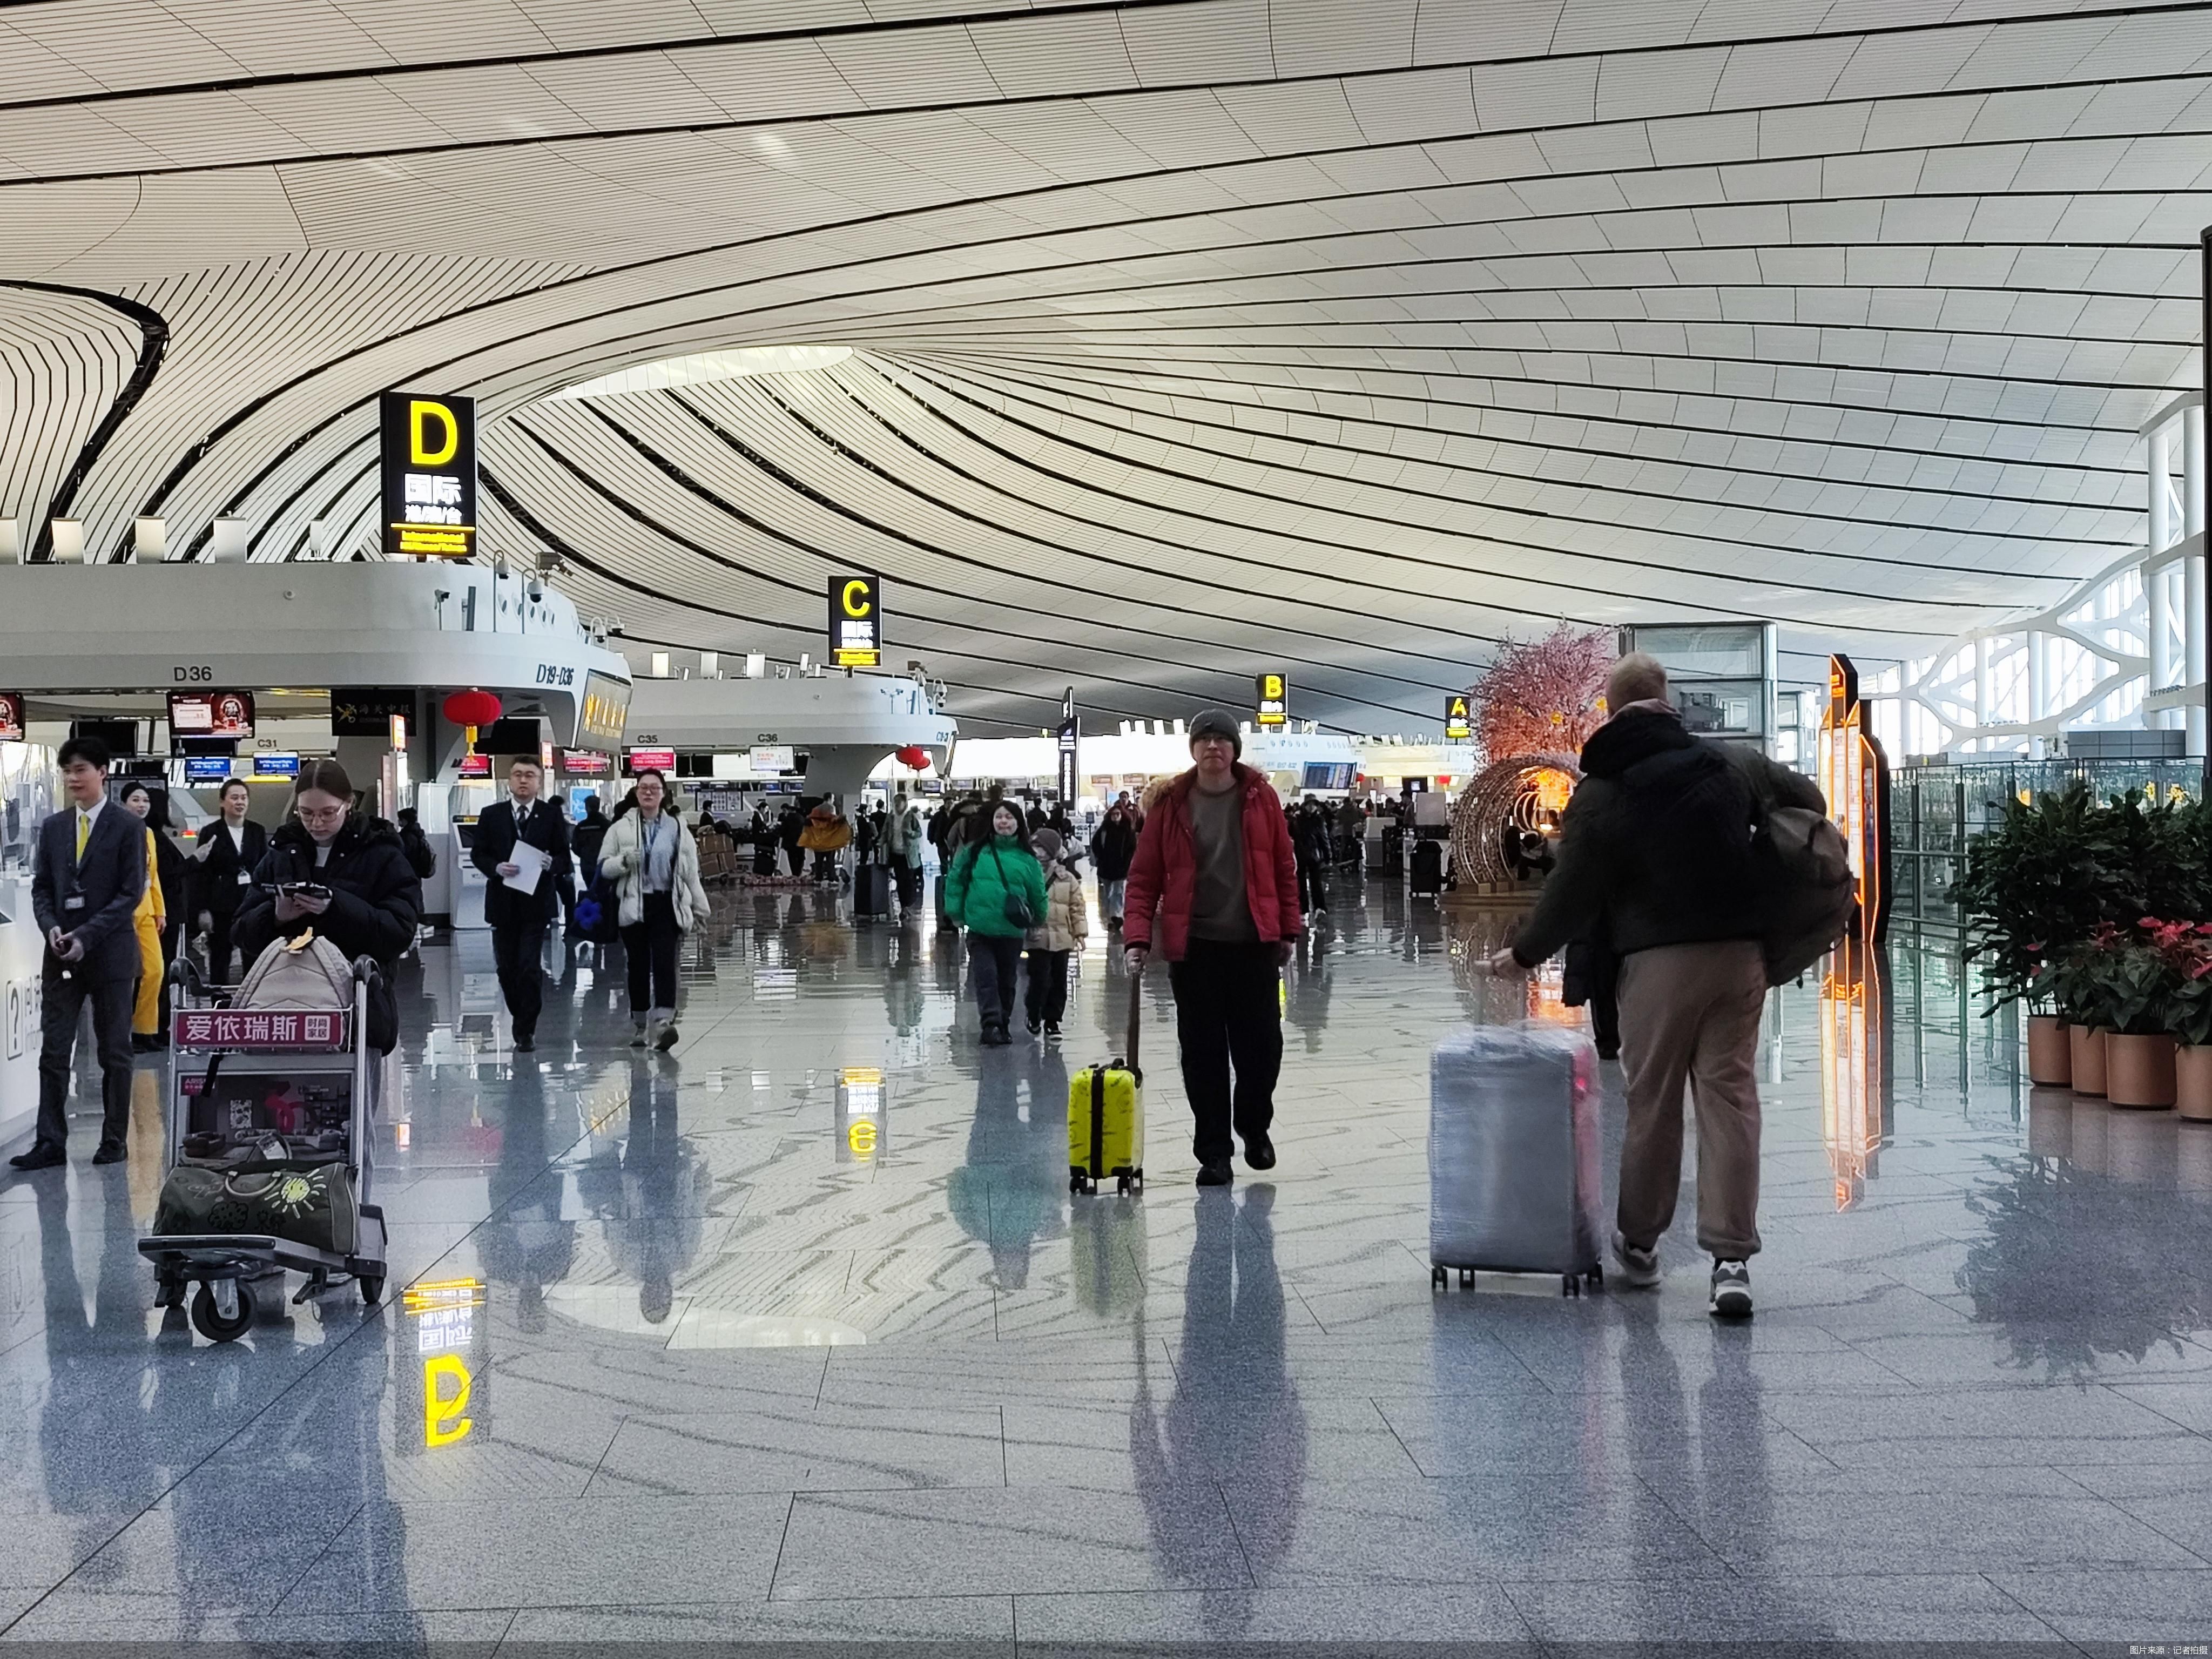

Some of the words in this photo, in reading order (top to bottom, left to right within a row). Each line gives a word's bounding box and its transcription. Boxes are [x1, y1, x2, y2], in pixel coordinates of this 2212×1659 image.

[410, 400, 457, 465] D
[404, 473, 462, 504] 国际
[842, 580, 870, 616] C
[173, 666, 212, 682] D36
[536, 664, 575, 686] D19-D36
[1266, 675, 1283, 697] B
[1451, 697, 1467, 716] A
[257, 739, 278, 748] C31
[637, 735, 658, 744] C35
[758, 733, 778, 743] C36
[186, 1015, 298, 1041] 爱依瑞斯
